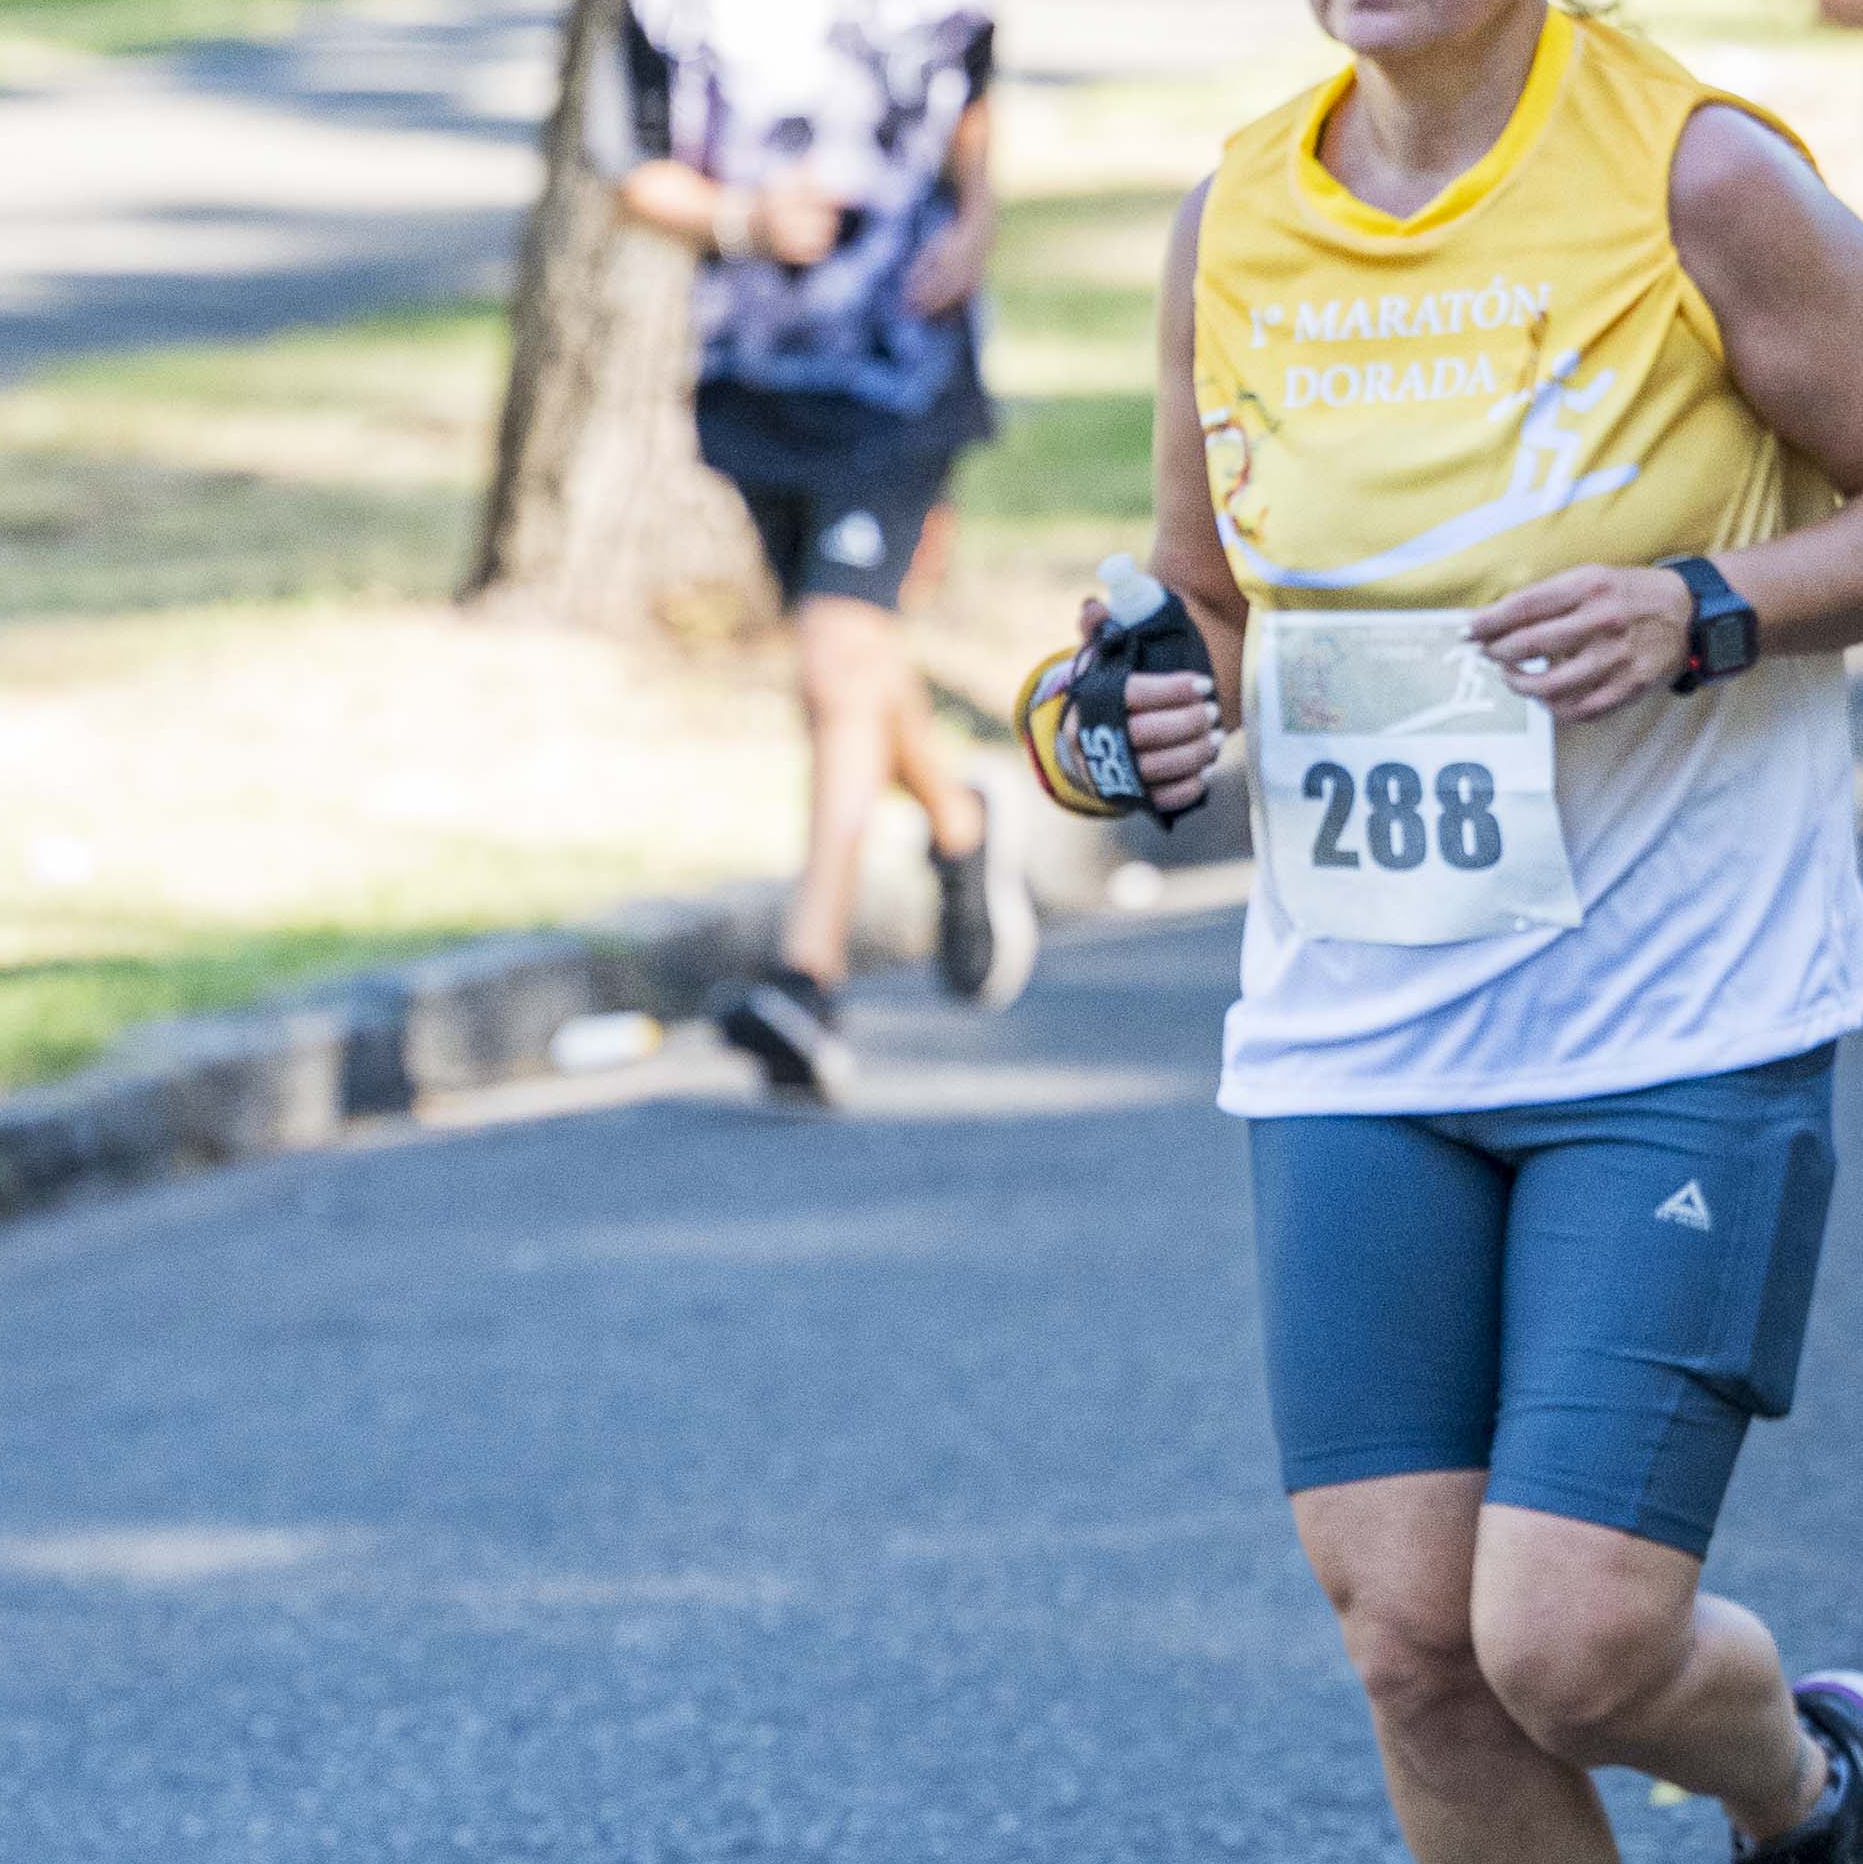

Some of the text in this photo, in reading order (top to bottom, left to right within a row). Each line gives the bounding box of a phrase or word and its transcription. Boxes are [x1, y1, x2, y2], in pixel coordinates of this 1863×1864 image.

[1292, 273, 1553, 345] MARATÓN
[1281, 350, 1498, 411] DORADA
[1300, 760, 1504, 873] 288
